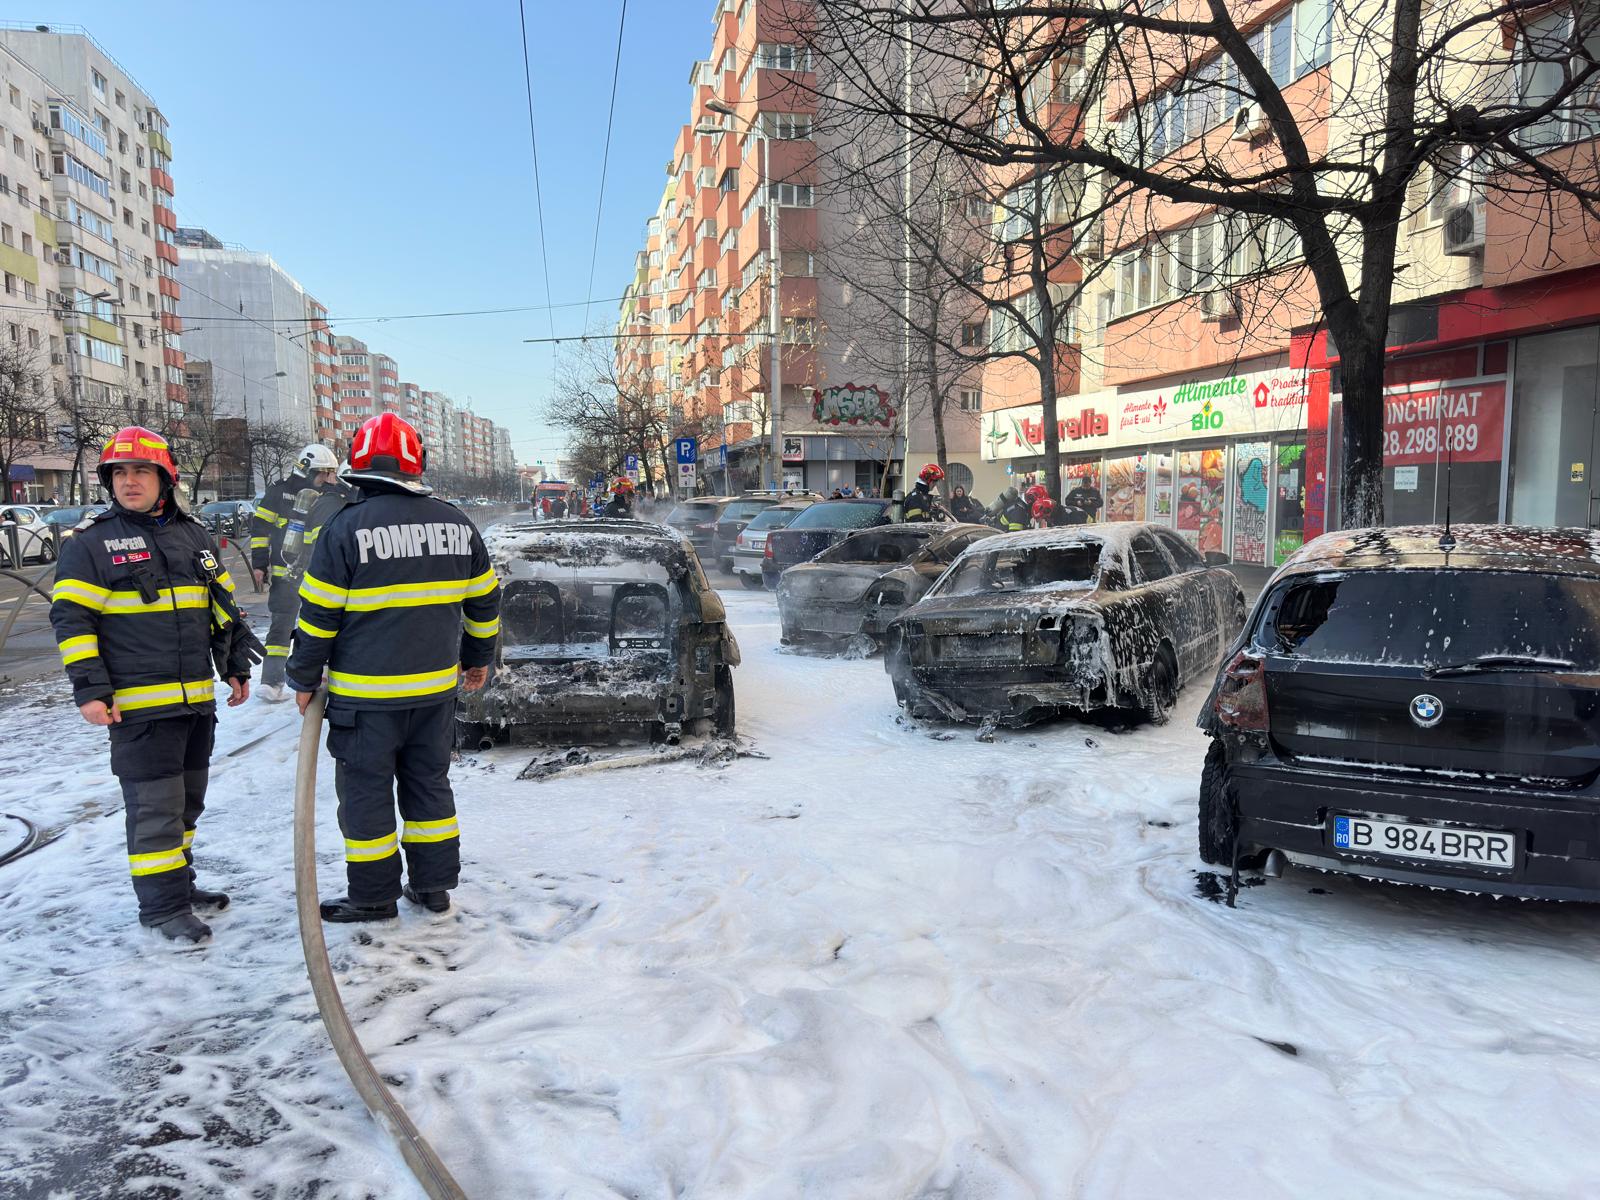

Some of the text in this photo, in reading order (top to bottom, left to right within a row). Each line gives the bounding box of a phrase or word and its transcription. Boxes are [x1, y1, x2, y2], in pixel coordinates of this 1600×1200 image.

[1173, 375, 1248, 405] Alimente
[680, 442, 691, 456] P
[1336, 833, 1349, 844] RO
[1353, 822, 1373, 846] B
